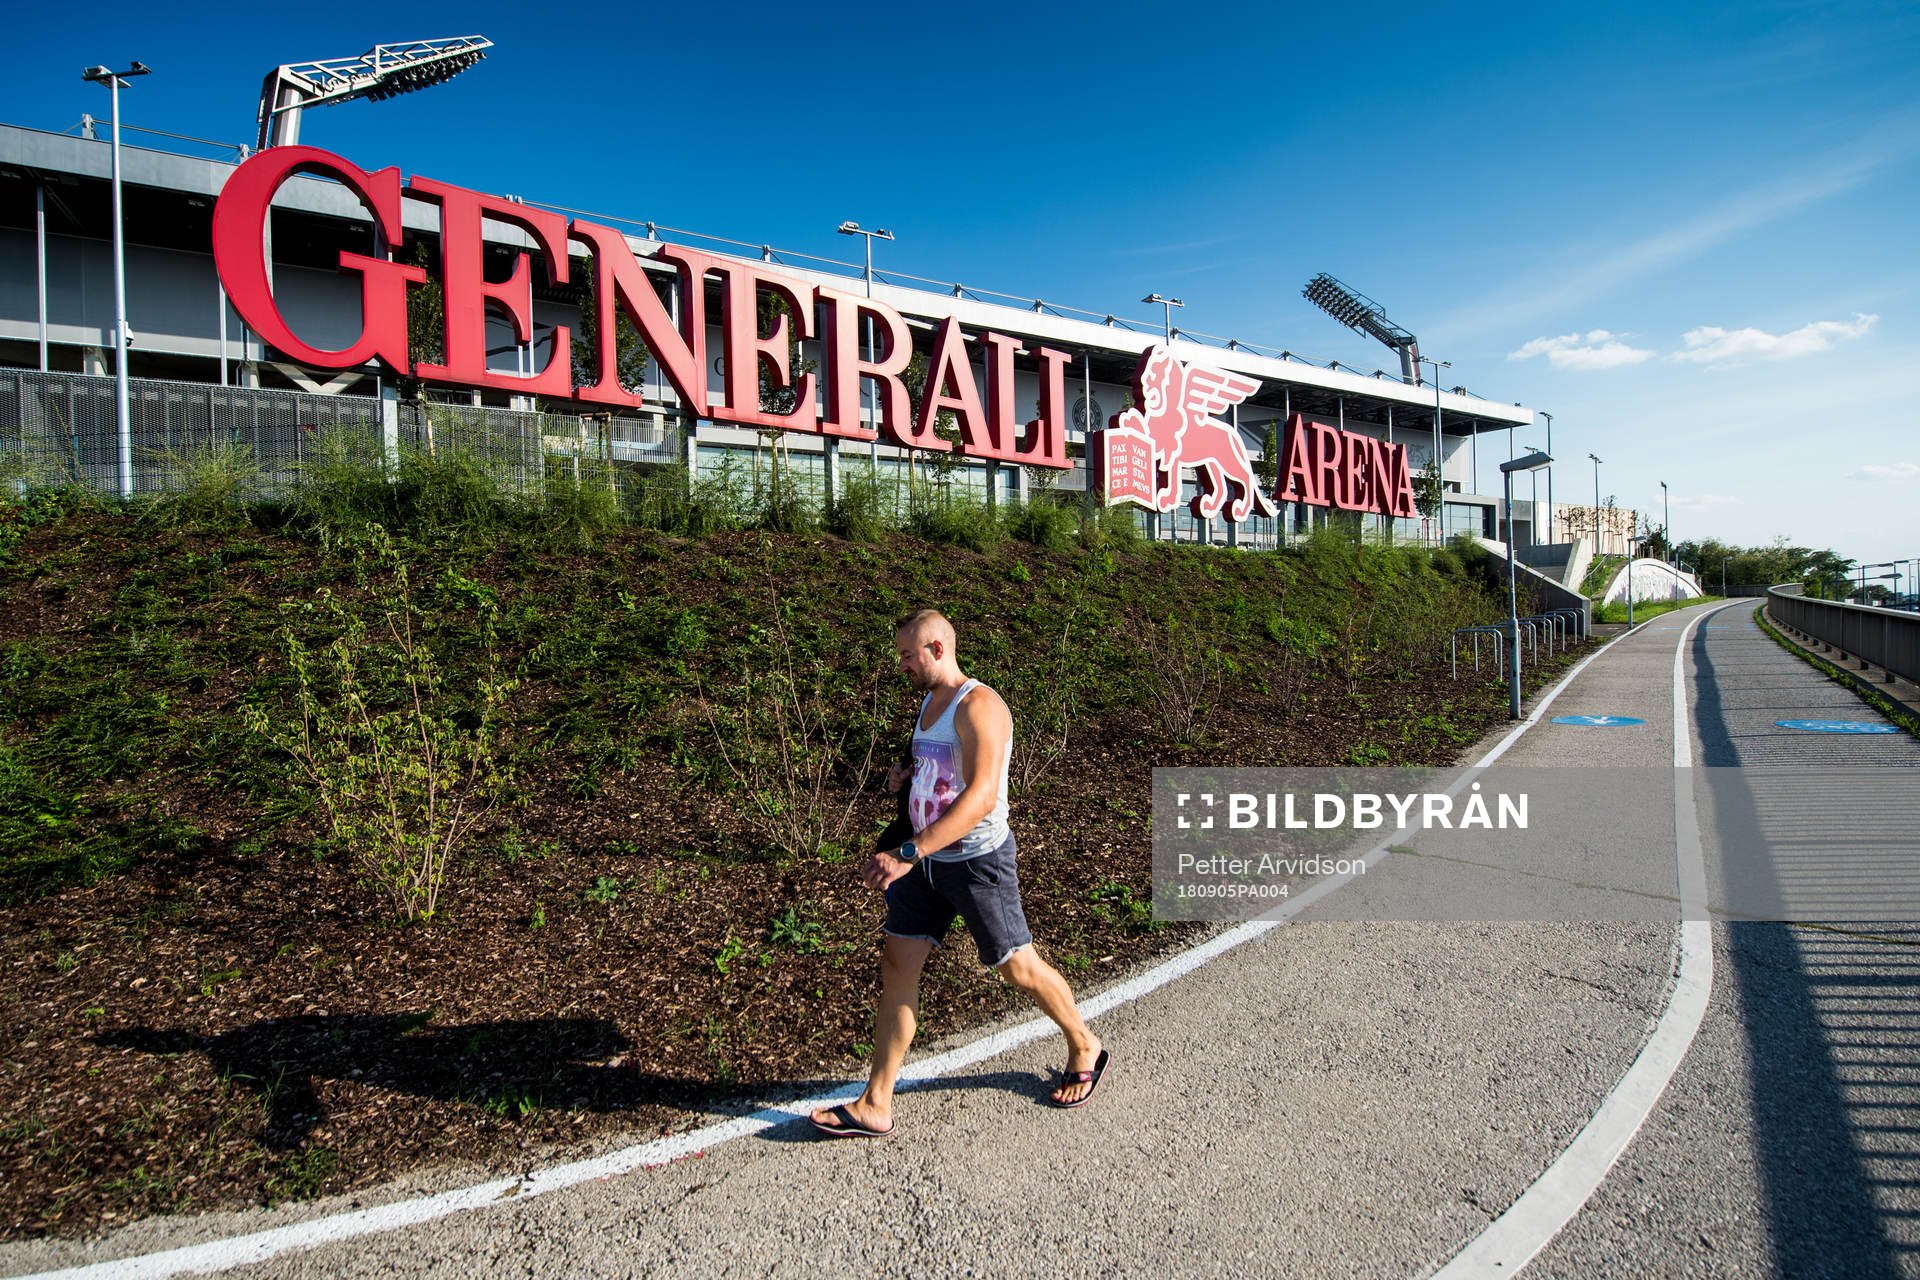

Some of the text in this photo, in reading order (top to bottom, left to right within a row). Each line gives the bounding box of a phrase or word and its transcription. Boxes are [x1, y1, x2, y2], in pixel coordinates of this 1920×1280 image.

[213, 146, 1074, 469] GENERALI
[1112, 444, 1126, 454] PAX
[1132, 444, 1146, 458] VAN
[1112, 455, 1128, 465] TIBI
[1132, 456, 1148, 470] GELI
[1277, 413, 1417, 518] ARENA
[1112, 466, 1128, 477] MAR
[1132, 468, 1146, 481] STA
[1112, 479, 1122, 489] CE
